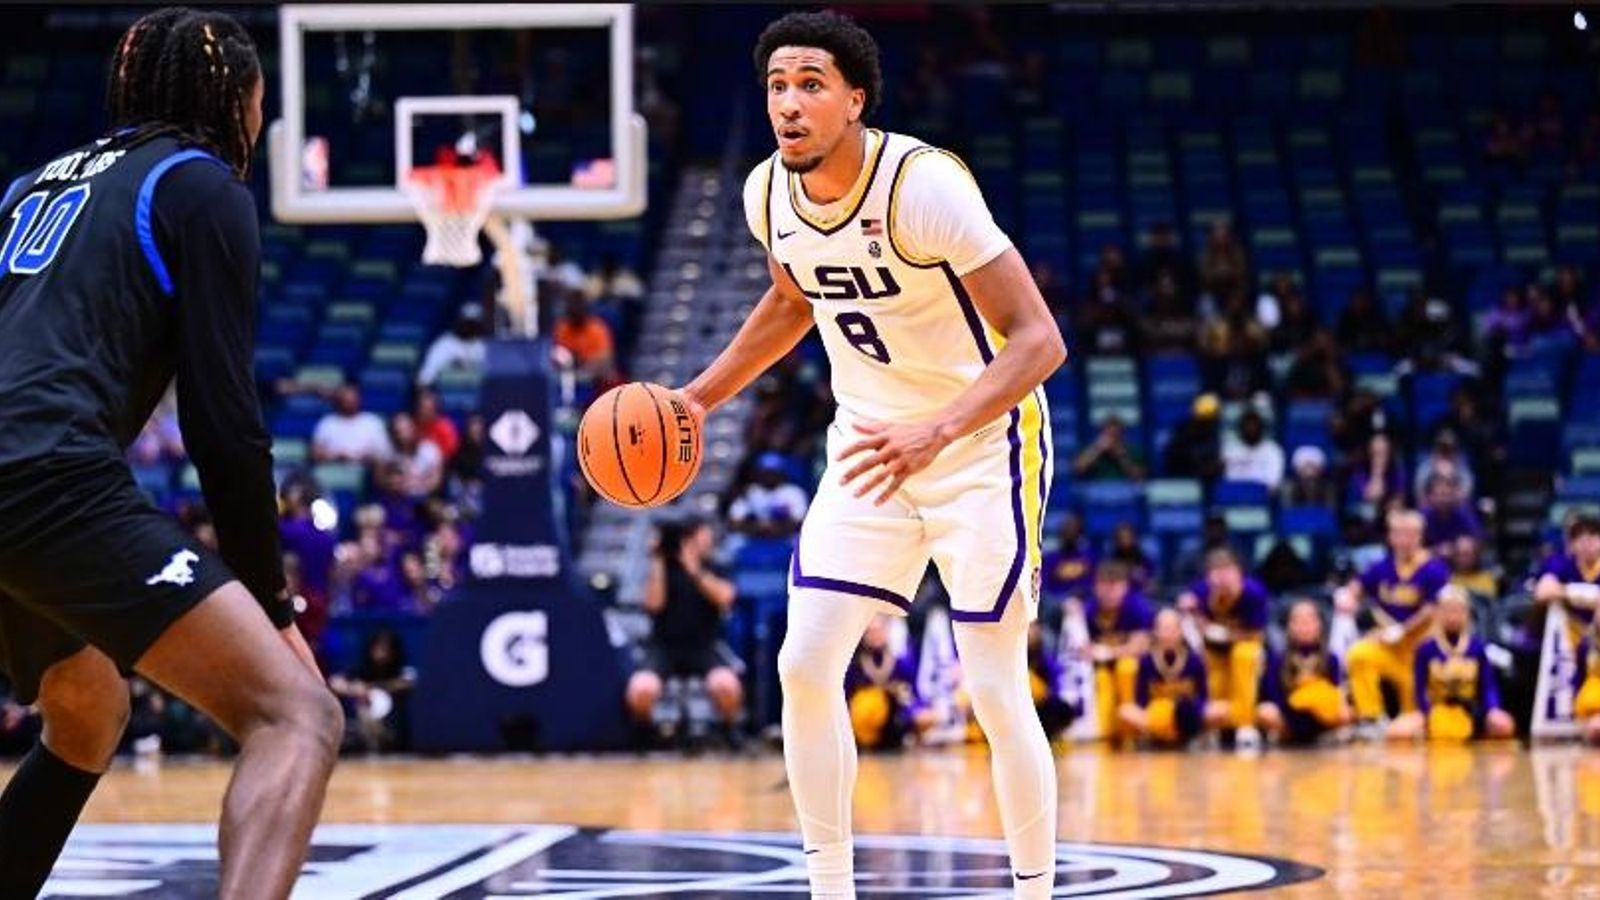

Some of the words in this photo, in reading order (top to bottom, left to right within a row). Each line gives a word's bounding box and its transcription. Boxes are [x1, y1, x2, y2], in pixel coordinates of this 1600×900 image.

[0, 182, 91, 275] 10
[782, 262, 902, 300] LSU
[835, 311, 891, 365] 8
[480, 610, 549, 687] G
